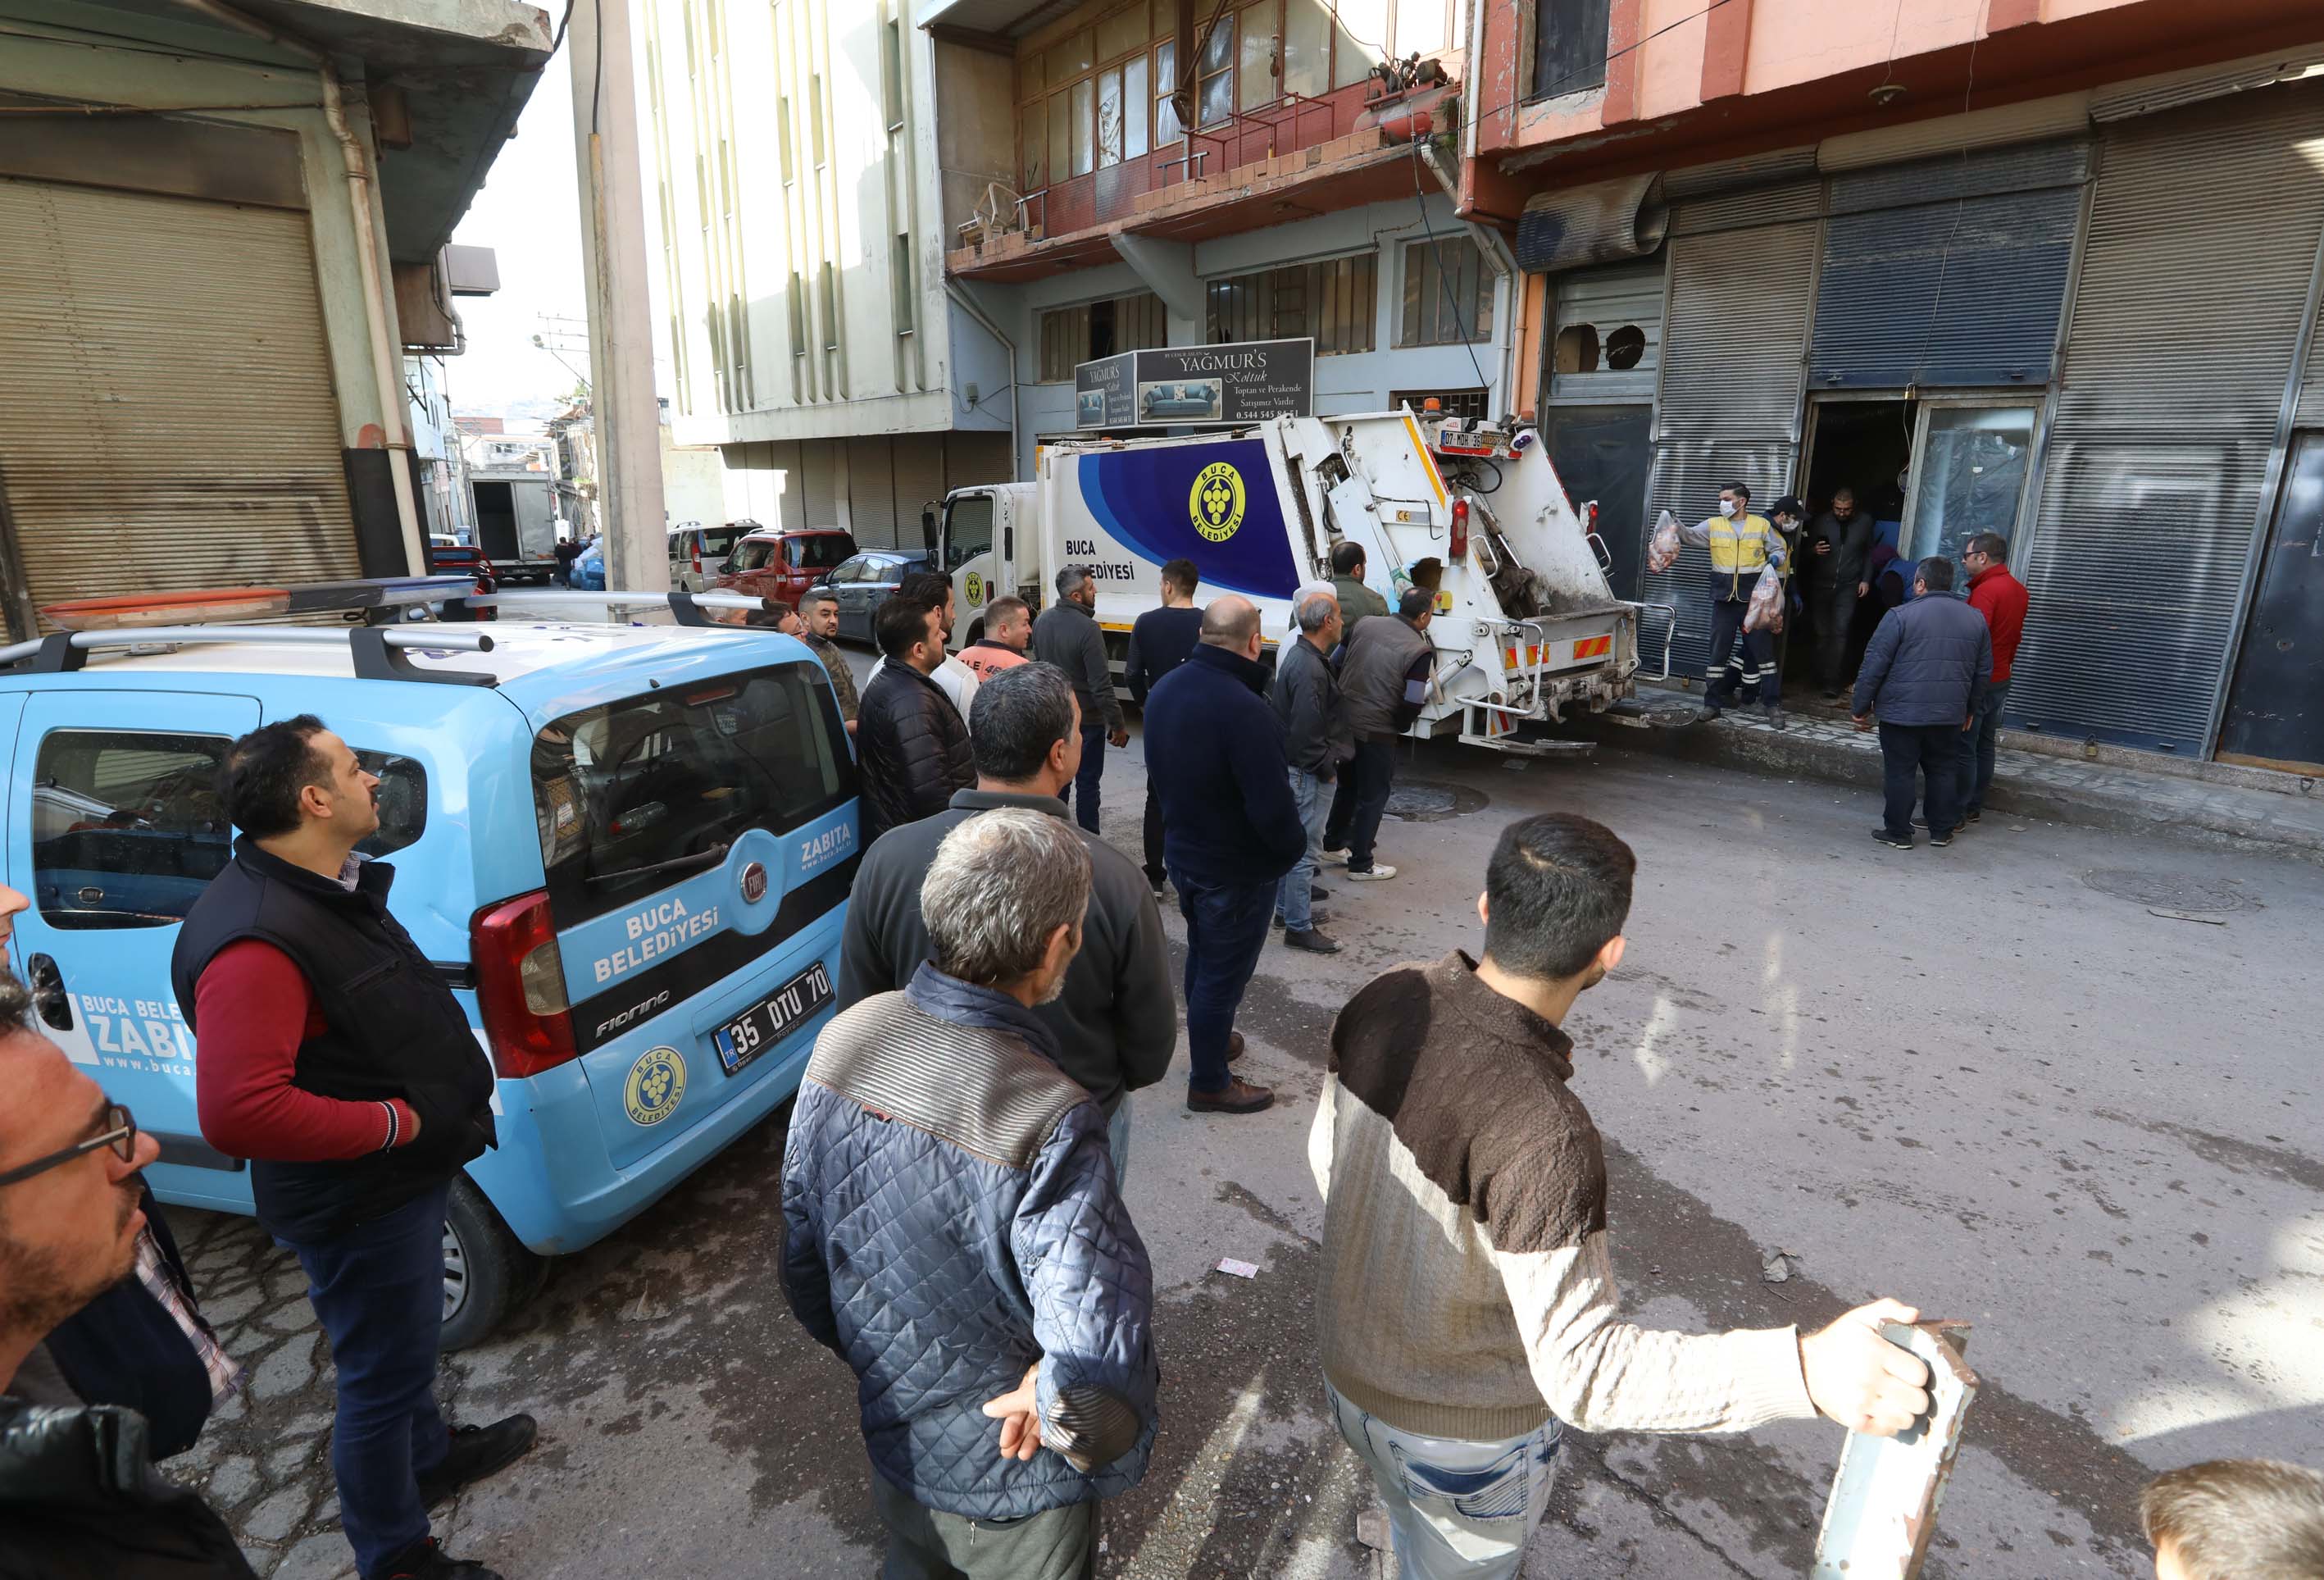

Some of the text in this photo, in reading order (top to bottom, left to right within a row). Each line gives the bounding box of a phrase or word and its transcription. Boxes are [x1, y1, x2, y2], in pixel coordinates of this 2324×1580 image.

[1180, 348, 1267, 371] YAĞMUR'S
[1225, 370, 1267, 384] Koltuk
[1234, 386, 1257, 397] Toptan
[1268, 383, 1303, 394] Perakende
[1240, 397, 1294, 408] Satışımız Vardır
[1236, 411, 1258, 419] 0.544
[1260, 410, 1275, 419] 545
[1445, 433, 1453, 444] 07
[1473, 435, 1480, 447] 36
[1202, 465, 1235, 480] BUCA
[1193, 512, 1242, 540] BELEDİYESİ
[1066, 540, 1096, 555] BUCA
[1067, 561, 1135, 580] EDİYESİ
[801, 822, 851, 862] ZABITA
[748, 872, 762, 895] FIAT
[626, 898, 687, 940] BUCA
[81, 995, 130, 1016] BUCA
[730, 968, 829, 1054] 35 DTU 70
[87, 1014, 193, 1061] ZABI
[636, 1052, 671, 1074] BUCA
[725, 1048, 735, 1059] TR
